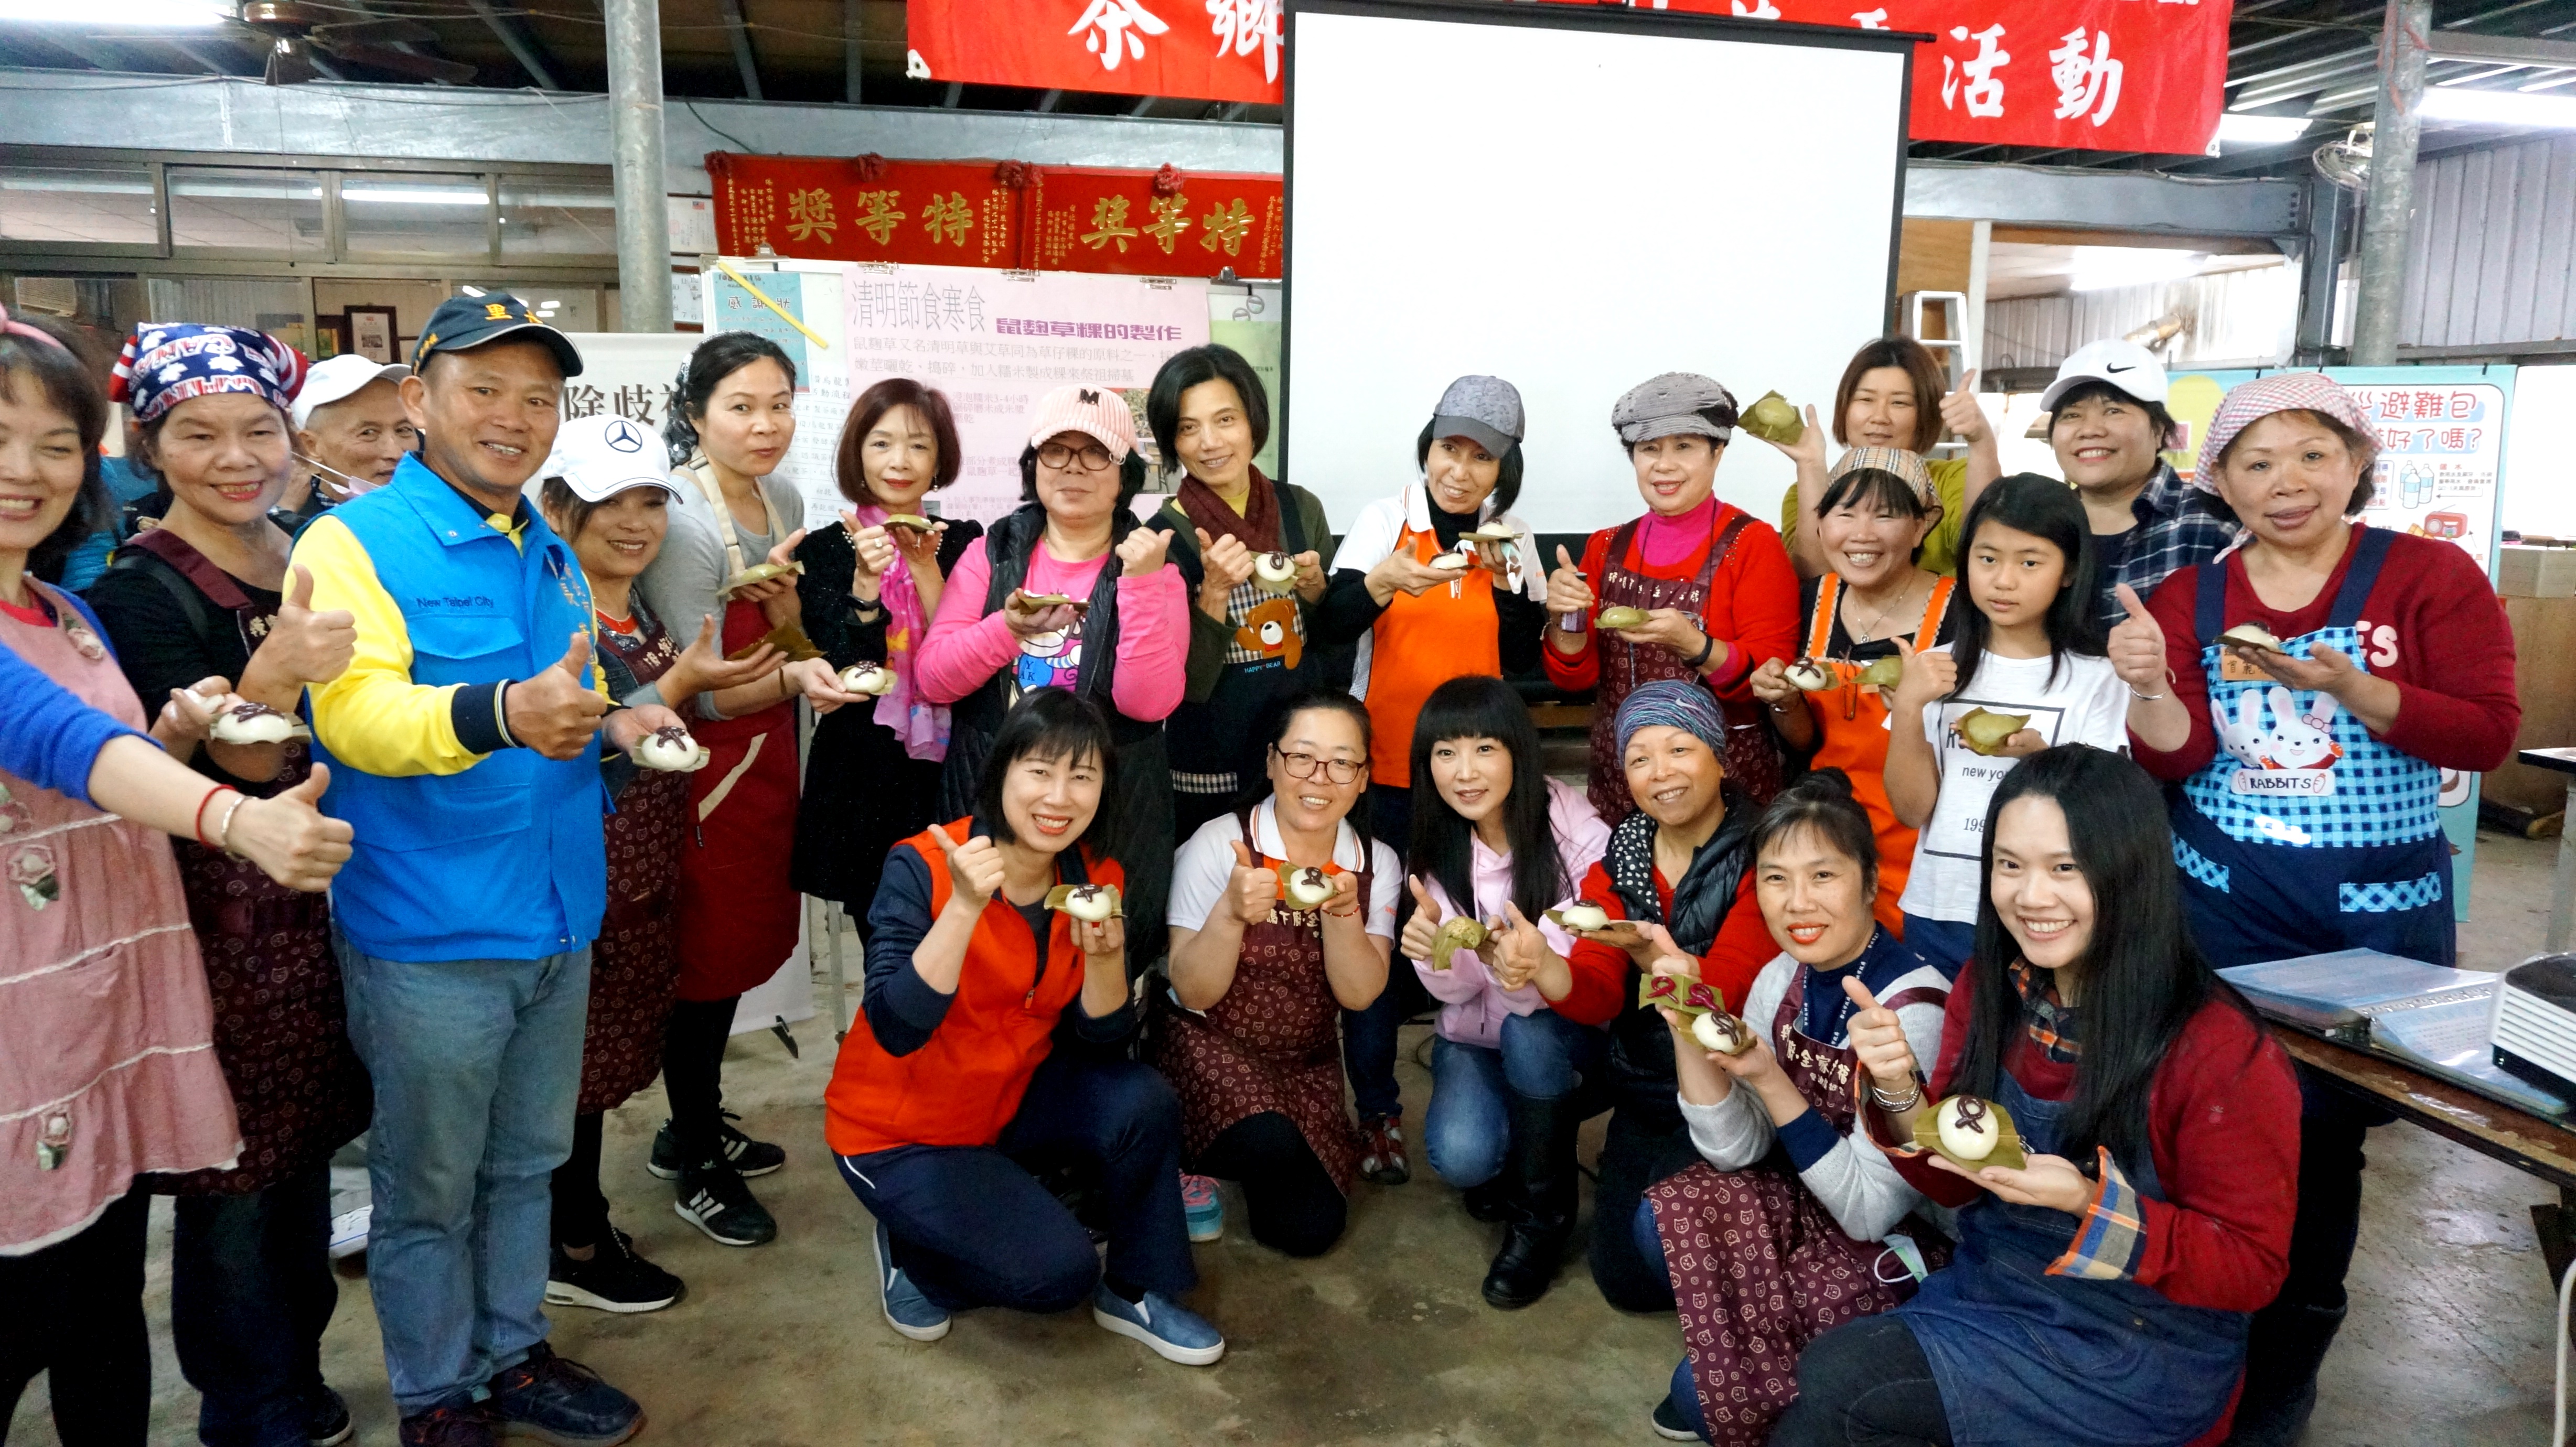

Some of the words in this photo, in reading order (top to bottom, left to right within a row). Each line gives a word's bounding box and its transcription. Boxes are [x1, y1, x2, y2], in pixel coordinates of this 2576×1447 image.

[1942, 22, 2123, 128] 活動
[851, 280, 986, 332] 清明節食寒食
[416, 597, 441, 608] New
[443, 596, 473, 608] Taipei
[474, 596, 494, 609] City
[1962, 766, 1987, 778] new
[1987, 770, 2008, 782] yo
[2250, 776, 2312, 790] RABBITS
